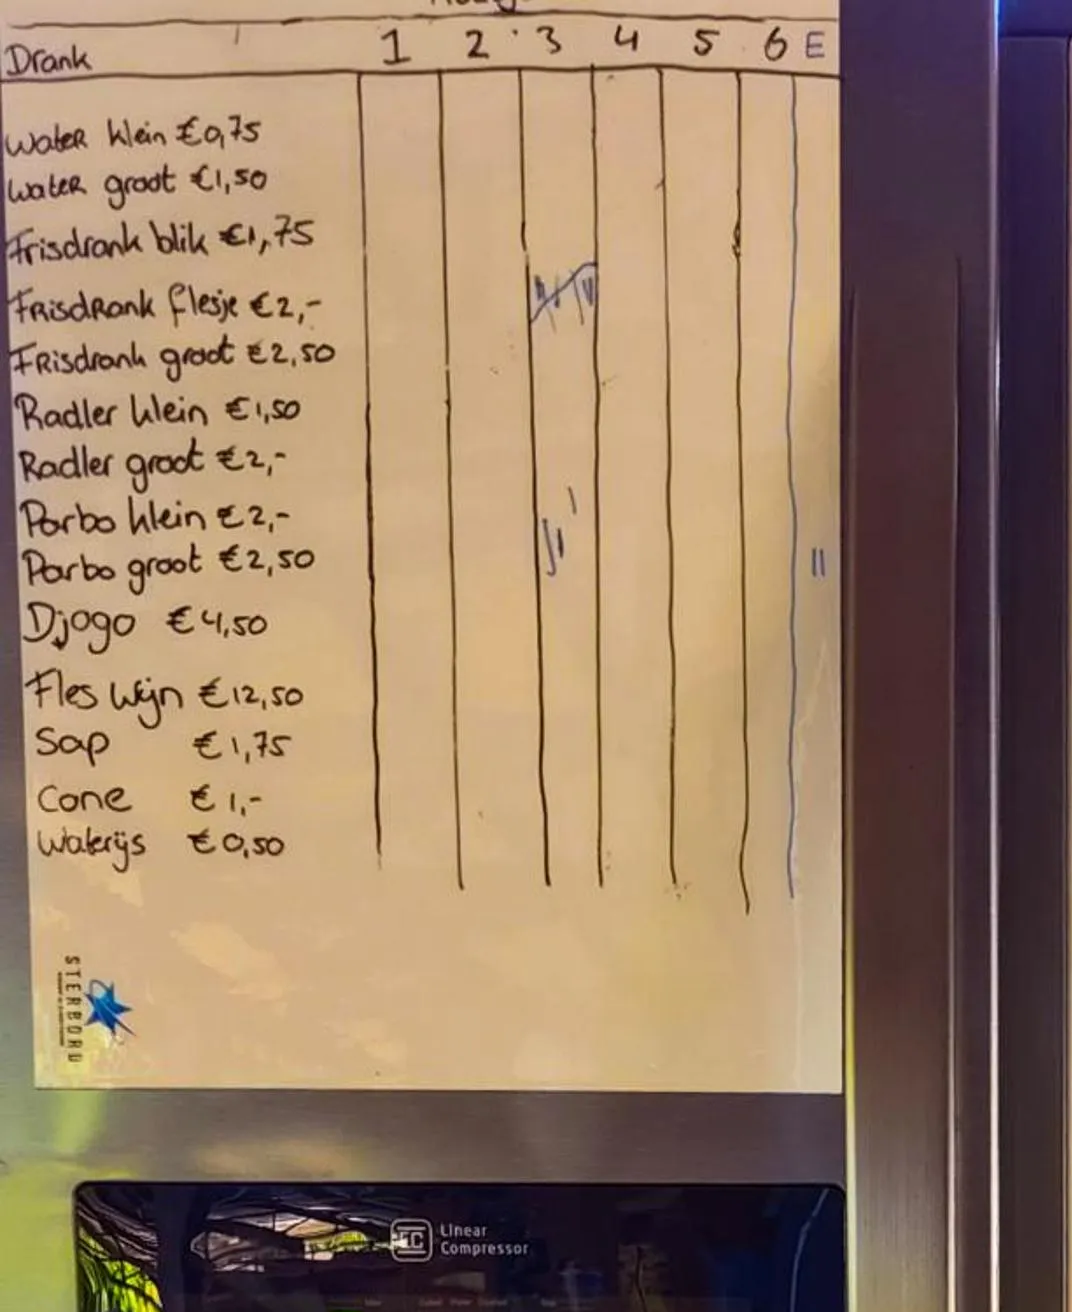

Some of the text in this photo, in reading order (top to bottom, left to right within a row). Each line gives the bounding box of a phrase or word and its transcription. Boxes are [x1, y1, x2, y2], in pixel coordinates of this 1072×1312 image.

[4, 24, 825, 76] Drank 1 2 3 4 5 6 E
[107, 118, 166, 147] klein
[104, 163, 176, 211] groot
[5, 221, 143, 266] Frisdrank
[150, 220, 209, 257] blik
[6, 287, 155, 324] Frisdrank
[168, 282, 239, 328] flesje
[9, 340, 146, 376] Frisdrank
[160, 335, 235, 382] groot
[15, 392, 118, 431] Radler
[130, 394, 208, 427] klein
[19, 445, 115, 482] Radler
[125, 437, 205, 494] groot
[20, 499, 117, 538] Parbo
[128, 496, 206, 535] klein
[22, 549, 116, 586] Parbo
[128, 543, 202, 595] groot
[25, 668, 98, 710] Fles
[35, 726, 110, 767] Sap
[37, 784, 133, 812] Cone
[440, 1242, 529, 1256] Compressor
